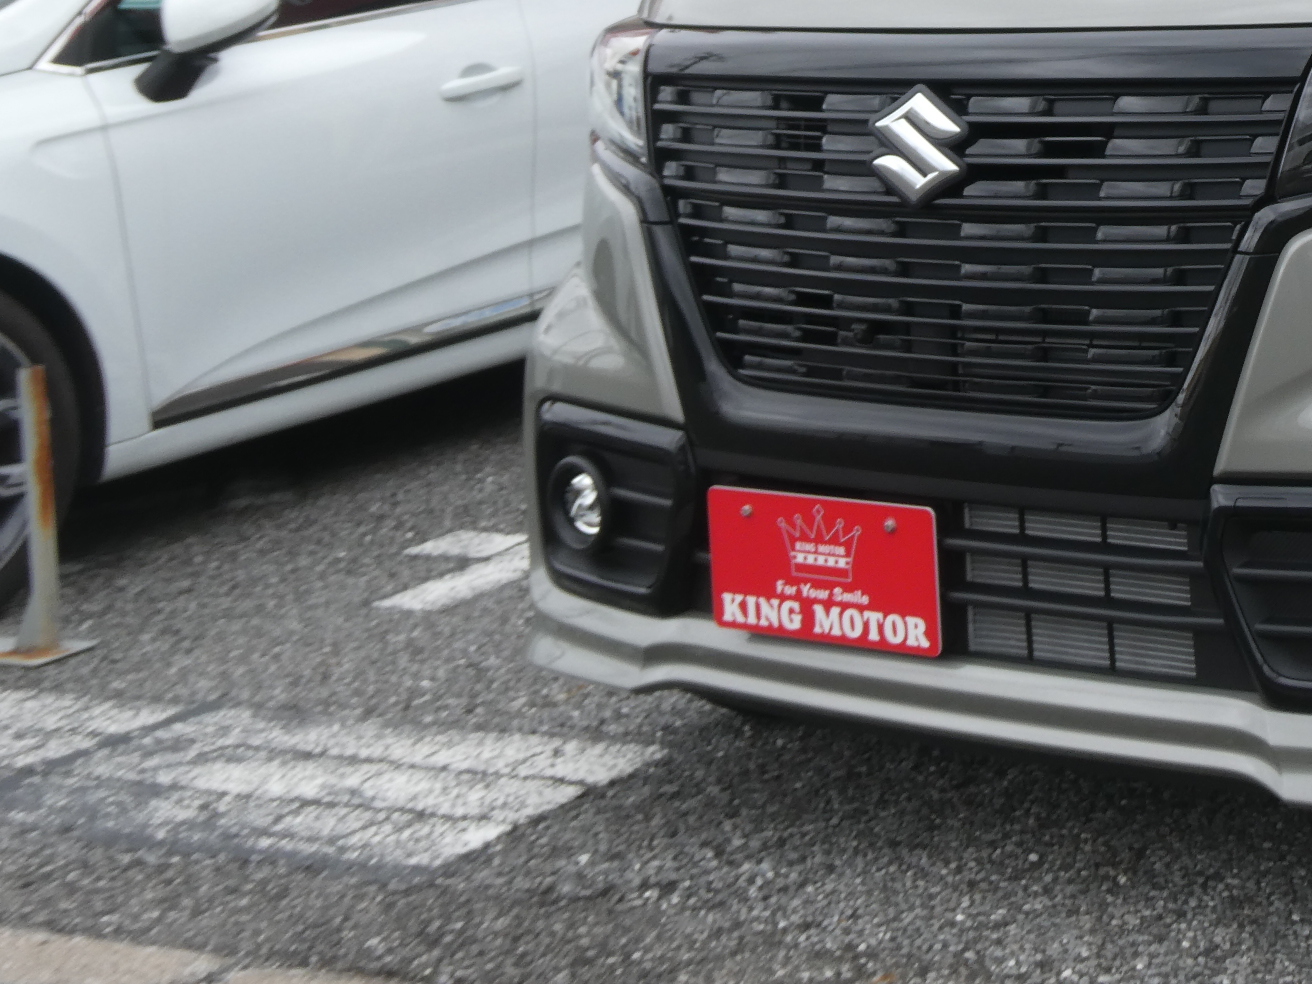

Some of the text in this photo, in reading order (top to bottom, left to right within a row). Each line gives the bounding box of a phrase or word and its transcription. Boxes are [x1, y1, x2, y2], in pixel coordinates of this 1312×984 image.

[795, 541, 846, 556] KING MOTOR
[776, 579, 869, 605] For Your Smile
[721, 592, 930, 648] KING MOTOR
